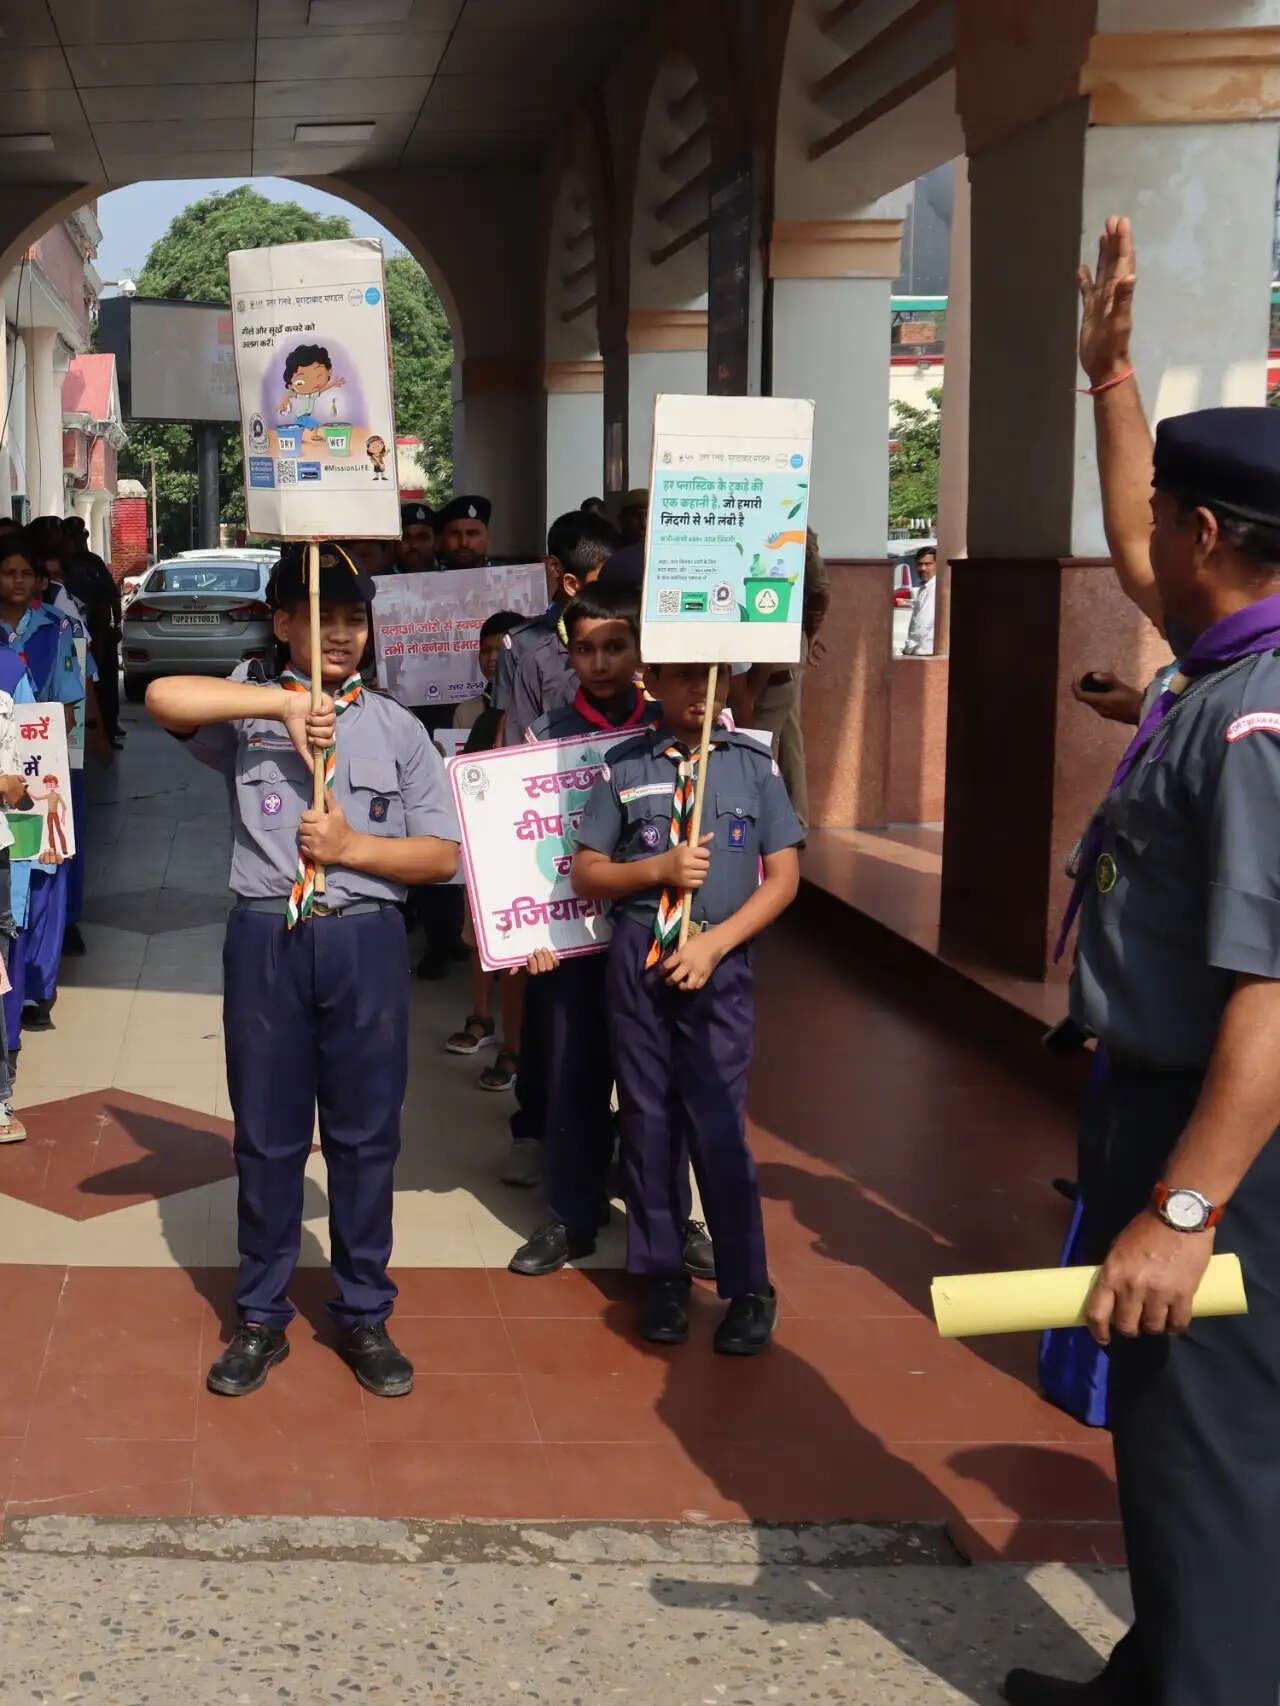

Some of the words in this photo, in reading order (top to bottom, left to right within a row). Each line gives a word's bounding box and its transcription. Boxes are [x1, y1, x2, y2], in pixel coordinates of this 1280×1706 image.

[280, 439, 294, 449] DRY
[329, 438, 344, 447] WET
[676, 476, 715, 490] प्लास्टिक
[717, 478, 726, 490] के
[751, 478, 763, 490] की
[663, 498, 678, 508] एक
[680, 495, 709, 509] कहानी
[723, 496, 735, 509] जो
[737, 496, 762, 510] हमारी
[692, 512, 701, 525] से
[704, 512, 715, 525] भी
[738, 511, 745, 527] है
[443, 617, 453, 632] से
[408, 641, 420, 655] तो
[421, 639, 450, 654] बनेगा
[20, 716, 51, 740] करें
[23, 755, 42, 777] में
[513, 809, 563, 842] दीप
